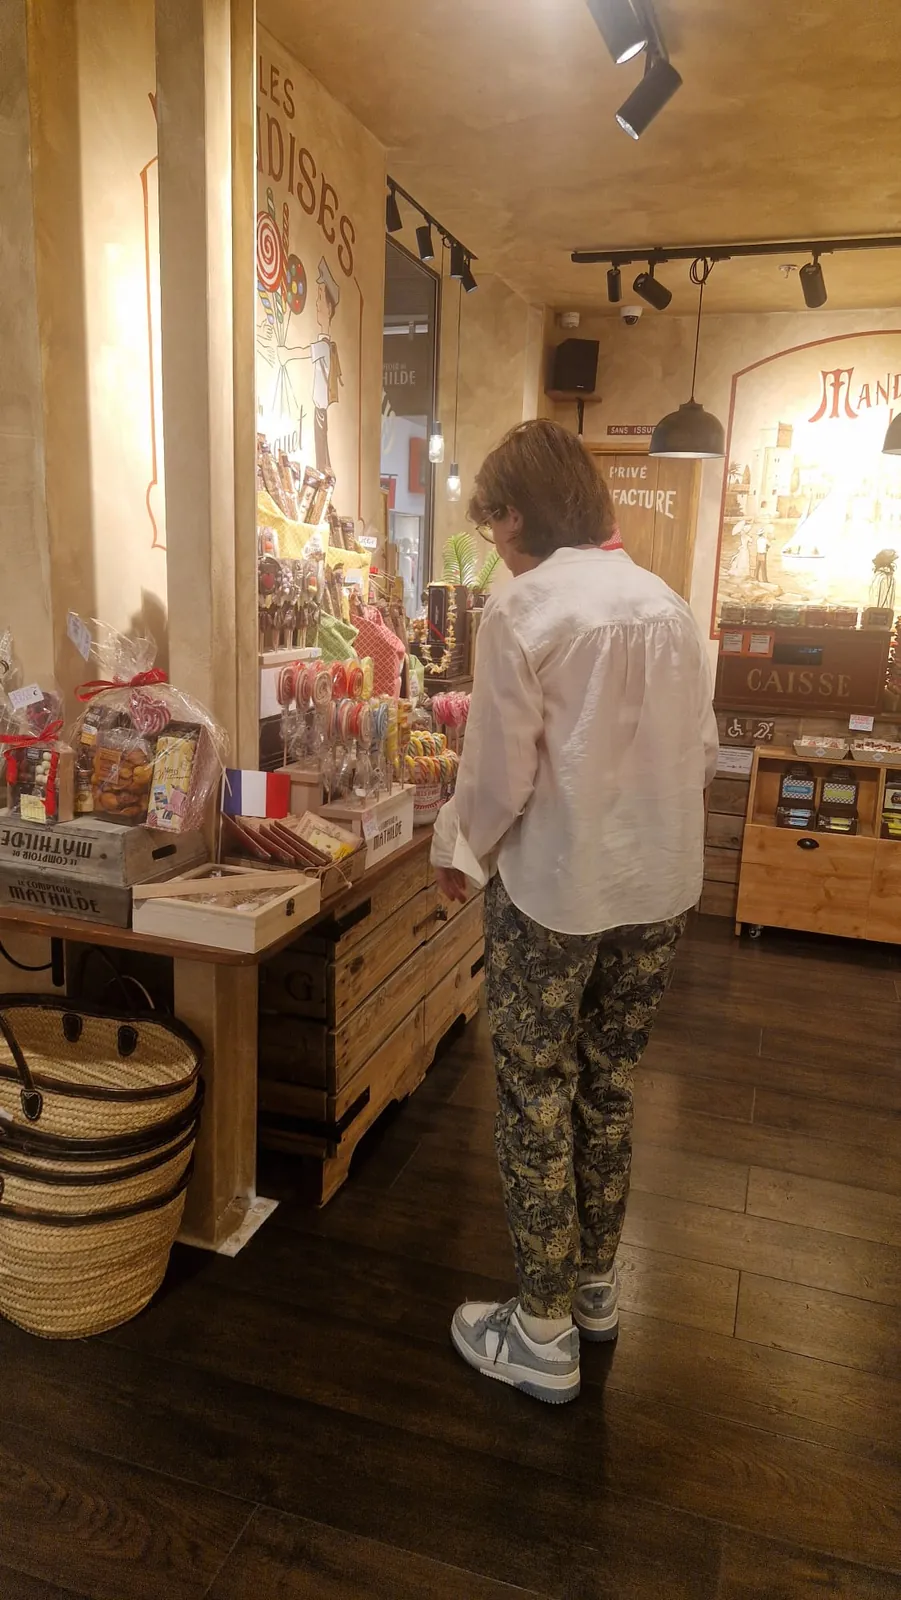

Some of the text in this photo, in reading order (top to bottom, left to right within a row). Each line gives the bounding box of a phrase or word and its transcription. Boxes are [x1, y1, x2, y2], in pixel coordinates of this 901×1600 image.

[259, 55, 295, 119] LES
[611, 426, 628, 434] SANS
[609, 465, 648, 479] PRIVÉ
[609, 488, 677, 519] FACTURE
[747, 668, 850, 697] CAISSE
[1, 830, 92, 858] MATHILDE
[373, 820, 402, 850] MATHILDE
[12, 849, 20, 857] DE
[23, 851, 68, 865] COMPTOIR
[8, 885, 101, 913] MATHILDE
[27, 881, 72, 895] COMPTOIR
